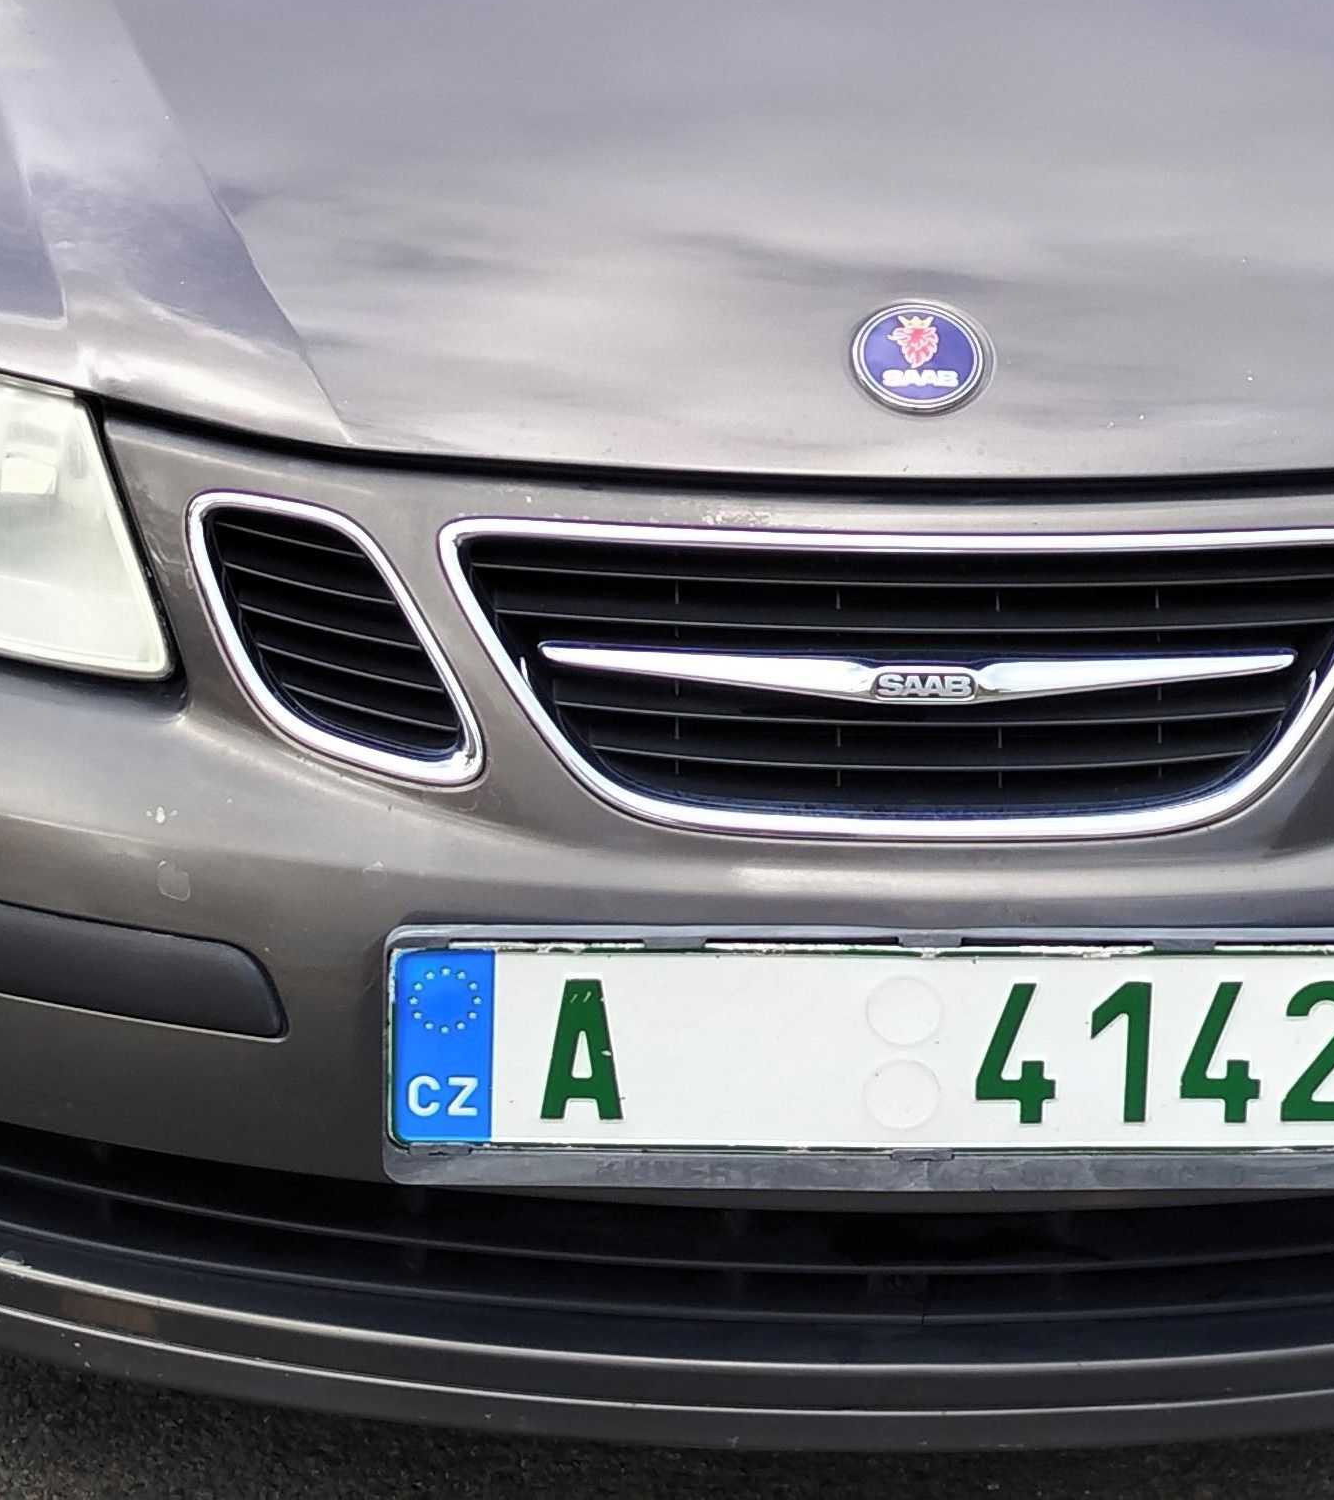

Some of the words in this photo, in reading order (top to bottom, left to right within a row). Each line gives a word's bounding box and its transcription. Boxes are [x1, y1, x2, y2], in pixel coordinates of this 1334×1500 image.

[881, 369, 959, 388] SAAB
[877, 673, 972, 697] SAAB
[540, 979, 624, 1120] A
[407, 1075, 478, 1117] CZ
